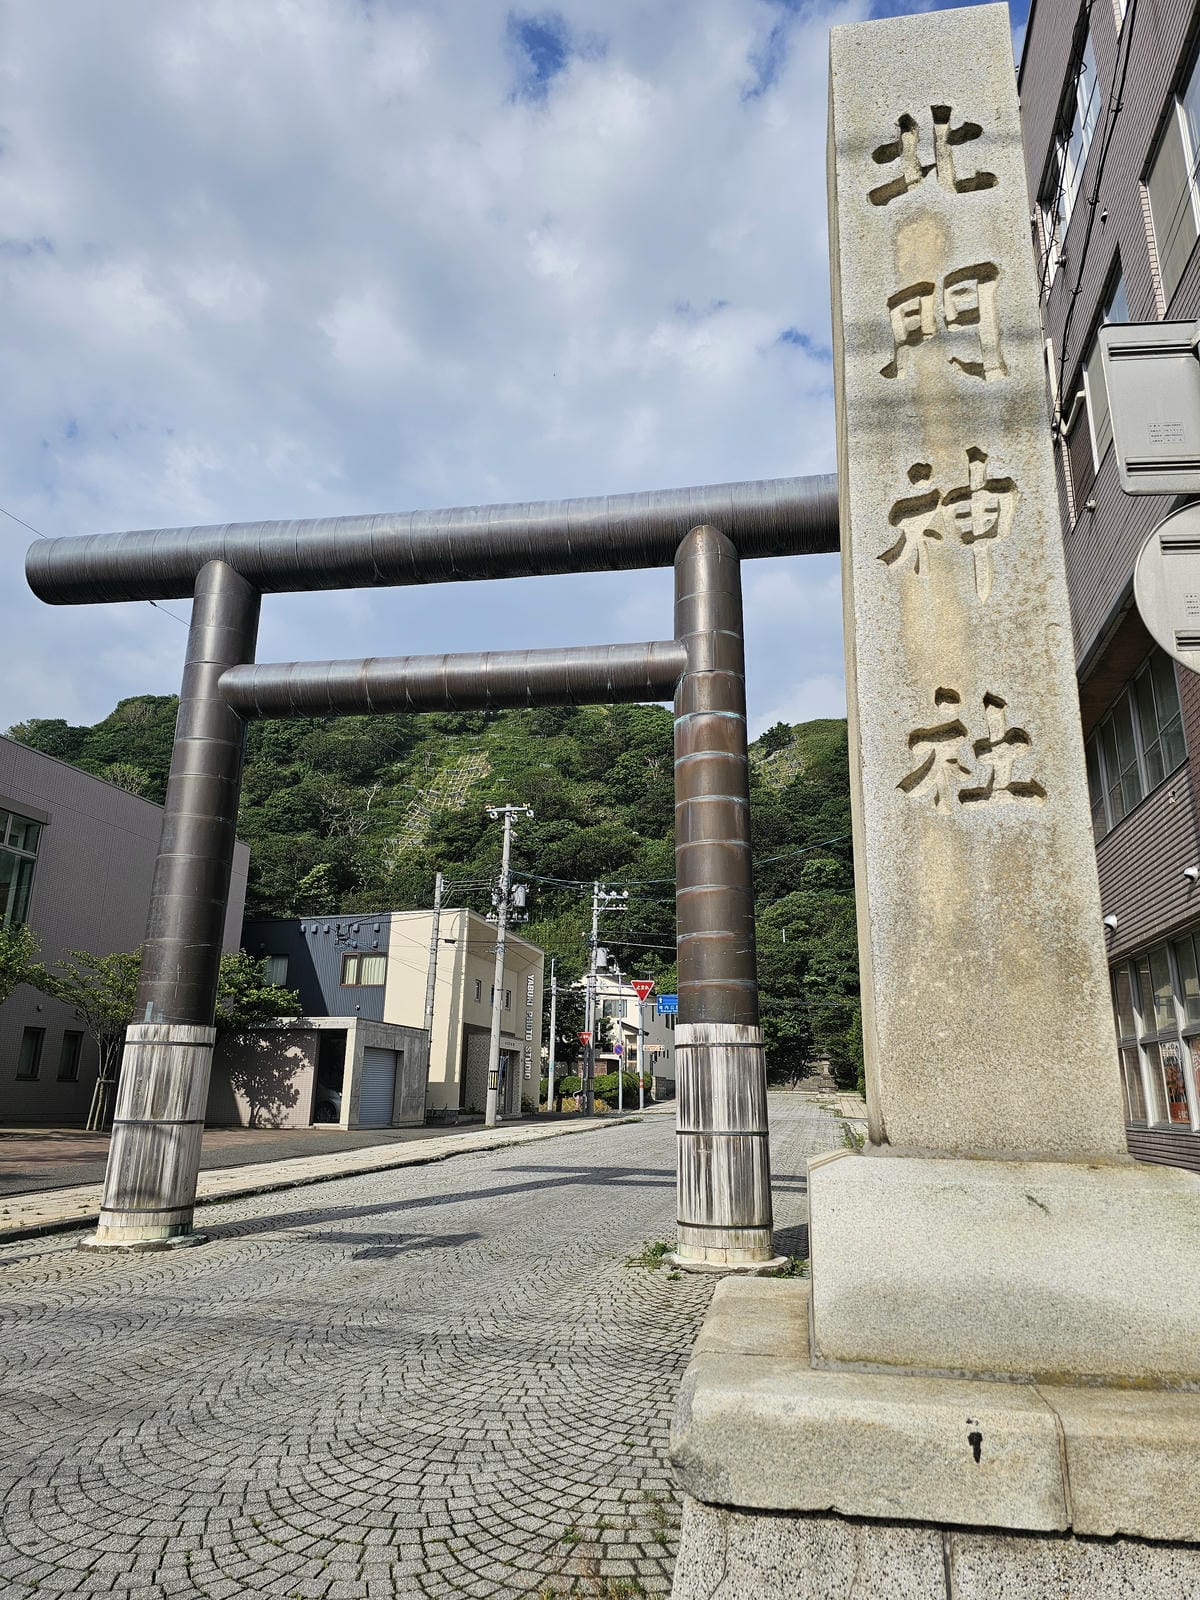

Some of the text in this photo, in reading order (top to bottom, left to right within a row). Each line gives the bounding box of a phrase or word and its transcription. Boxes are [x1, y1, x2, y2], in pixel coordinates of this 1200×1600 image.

[867, 104, 1047, 815] 北門神社
[524, 974, 535, 1080] YABUKI PHOTO STUDIO
